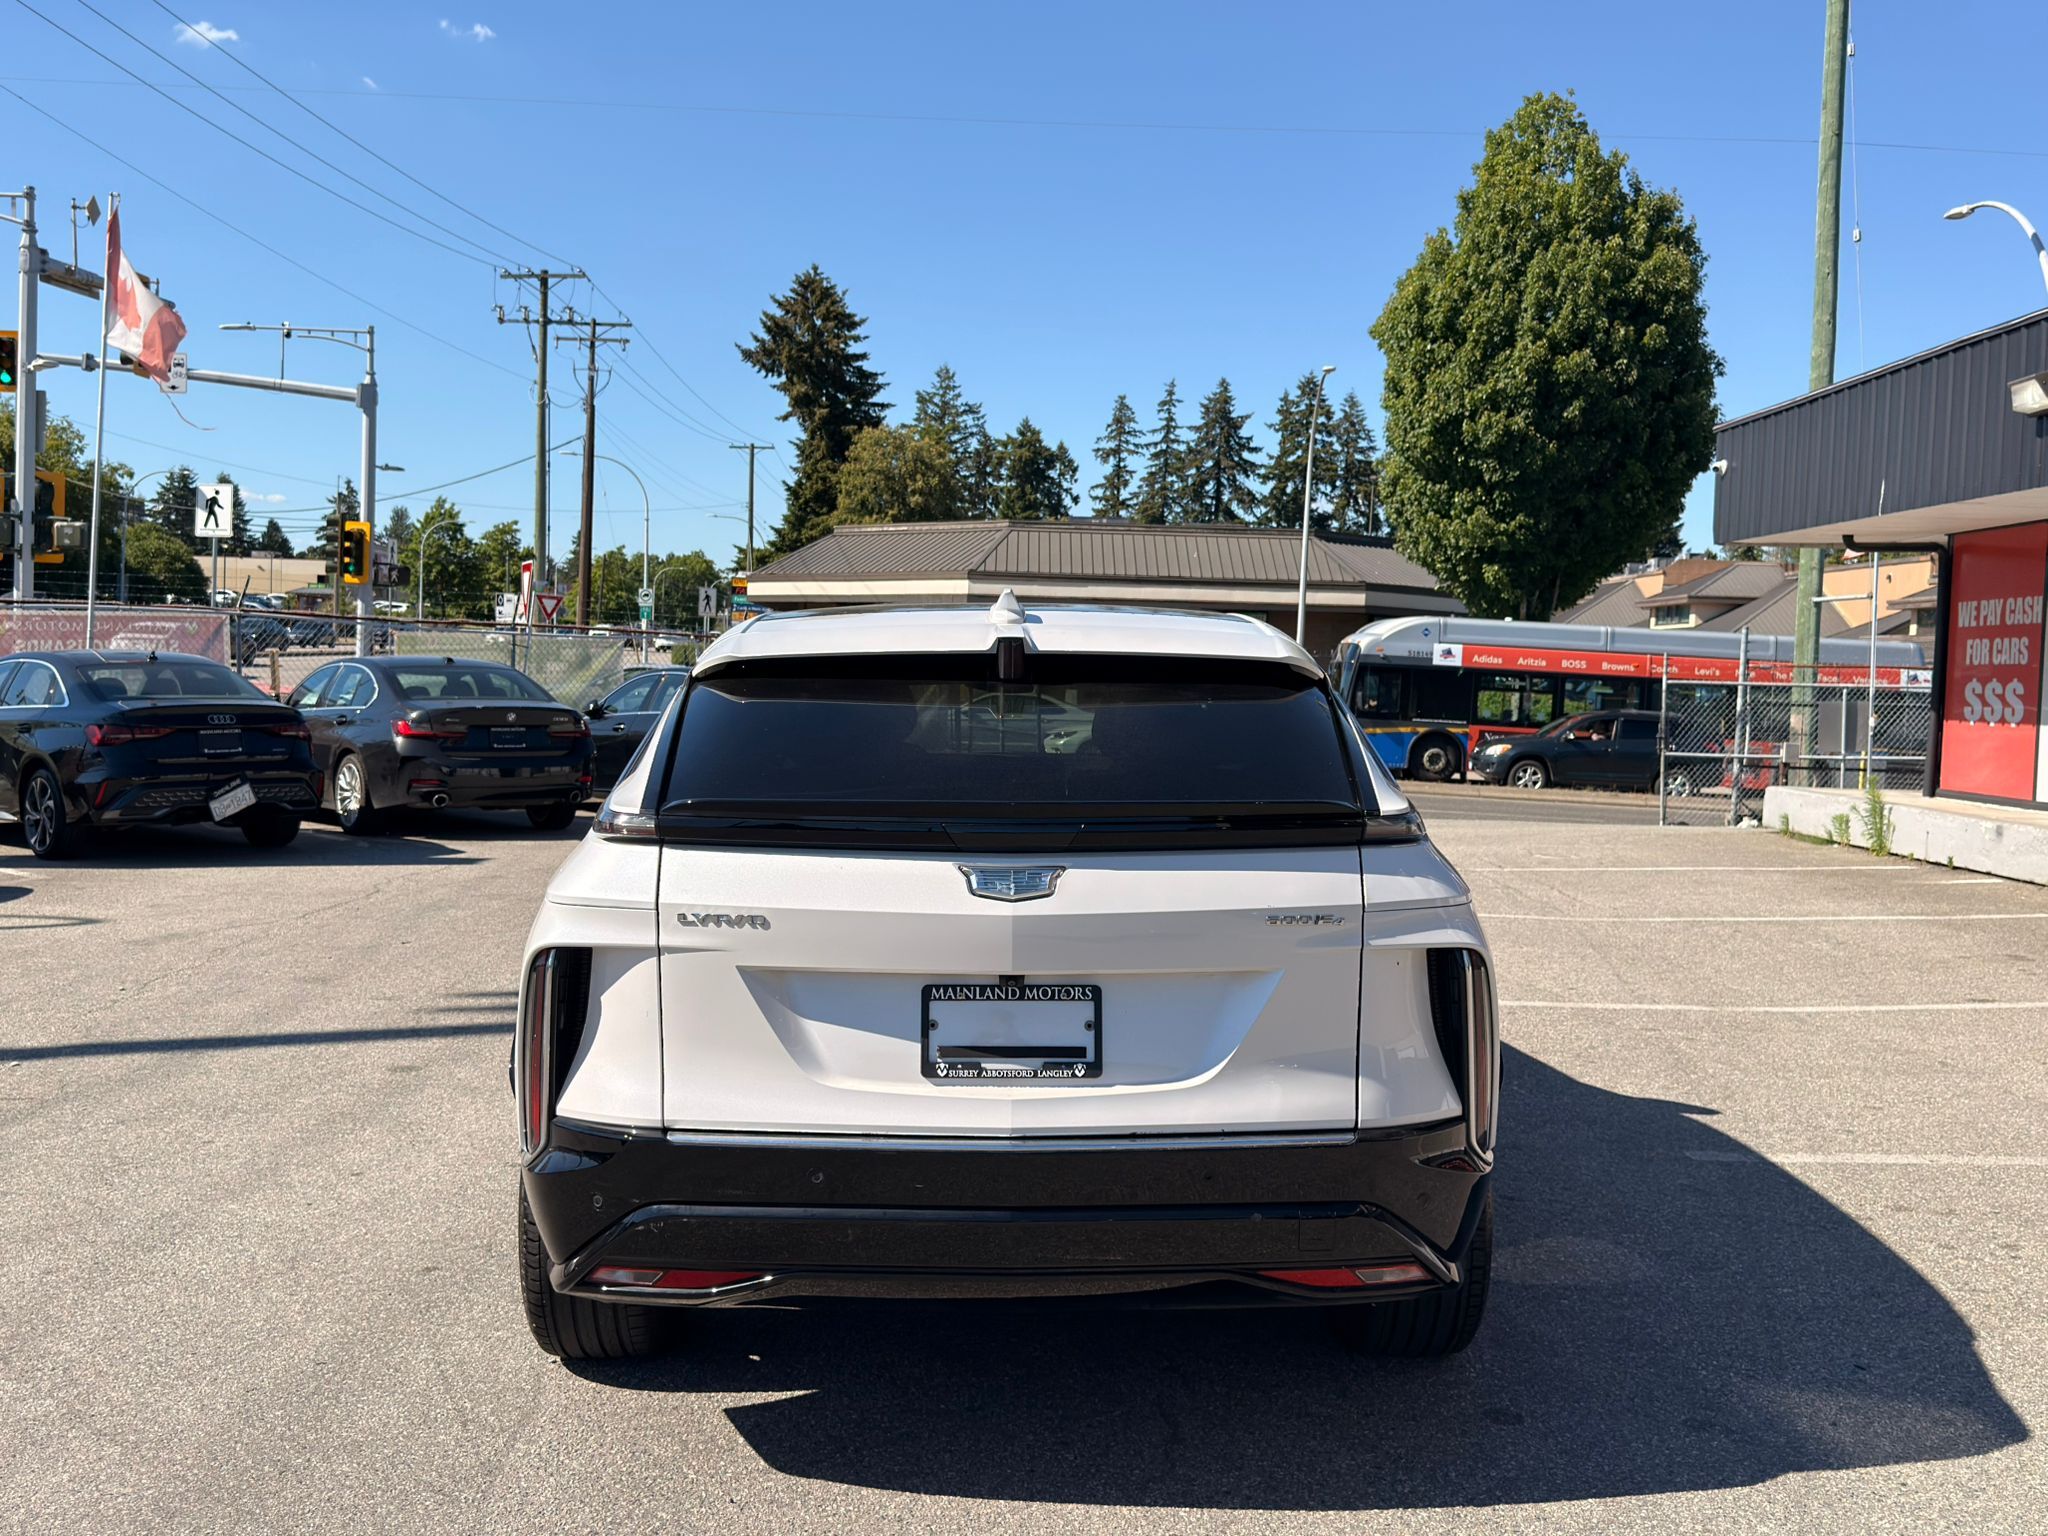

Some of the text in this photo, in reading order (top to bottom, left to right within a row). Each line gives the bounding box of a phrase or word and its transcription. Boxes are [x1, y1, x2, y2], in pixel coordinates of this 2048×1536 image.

[1958, 596, 2043, 628] WE PAY CASH
[1966, 636, 2029, 666] FOR CARS
[1472, 654, 1503, 665] Adidas
[1517, 656, 1547, 667] Aritzia
[1561, 659, 1587, 669] BOSS
[1601, 661, 1635, 672] Browns
[1695, 666, 1720, 677] Levi's
[1963, 677, 2025, 727] $$$
[931, 986, 1093, 1000] MAINLAND MOTORS
[948, 1069, 1073, 1078] SURREY ABBOTSFORD LANGLEY
